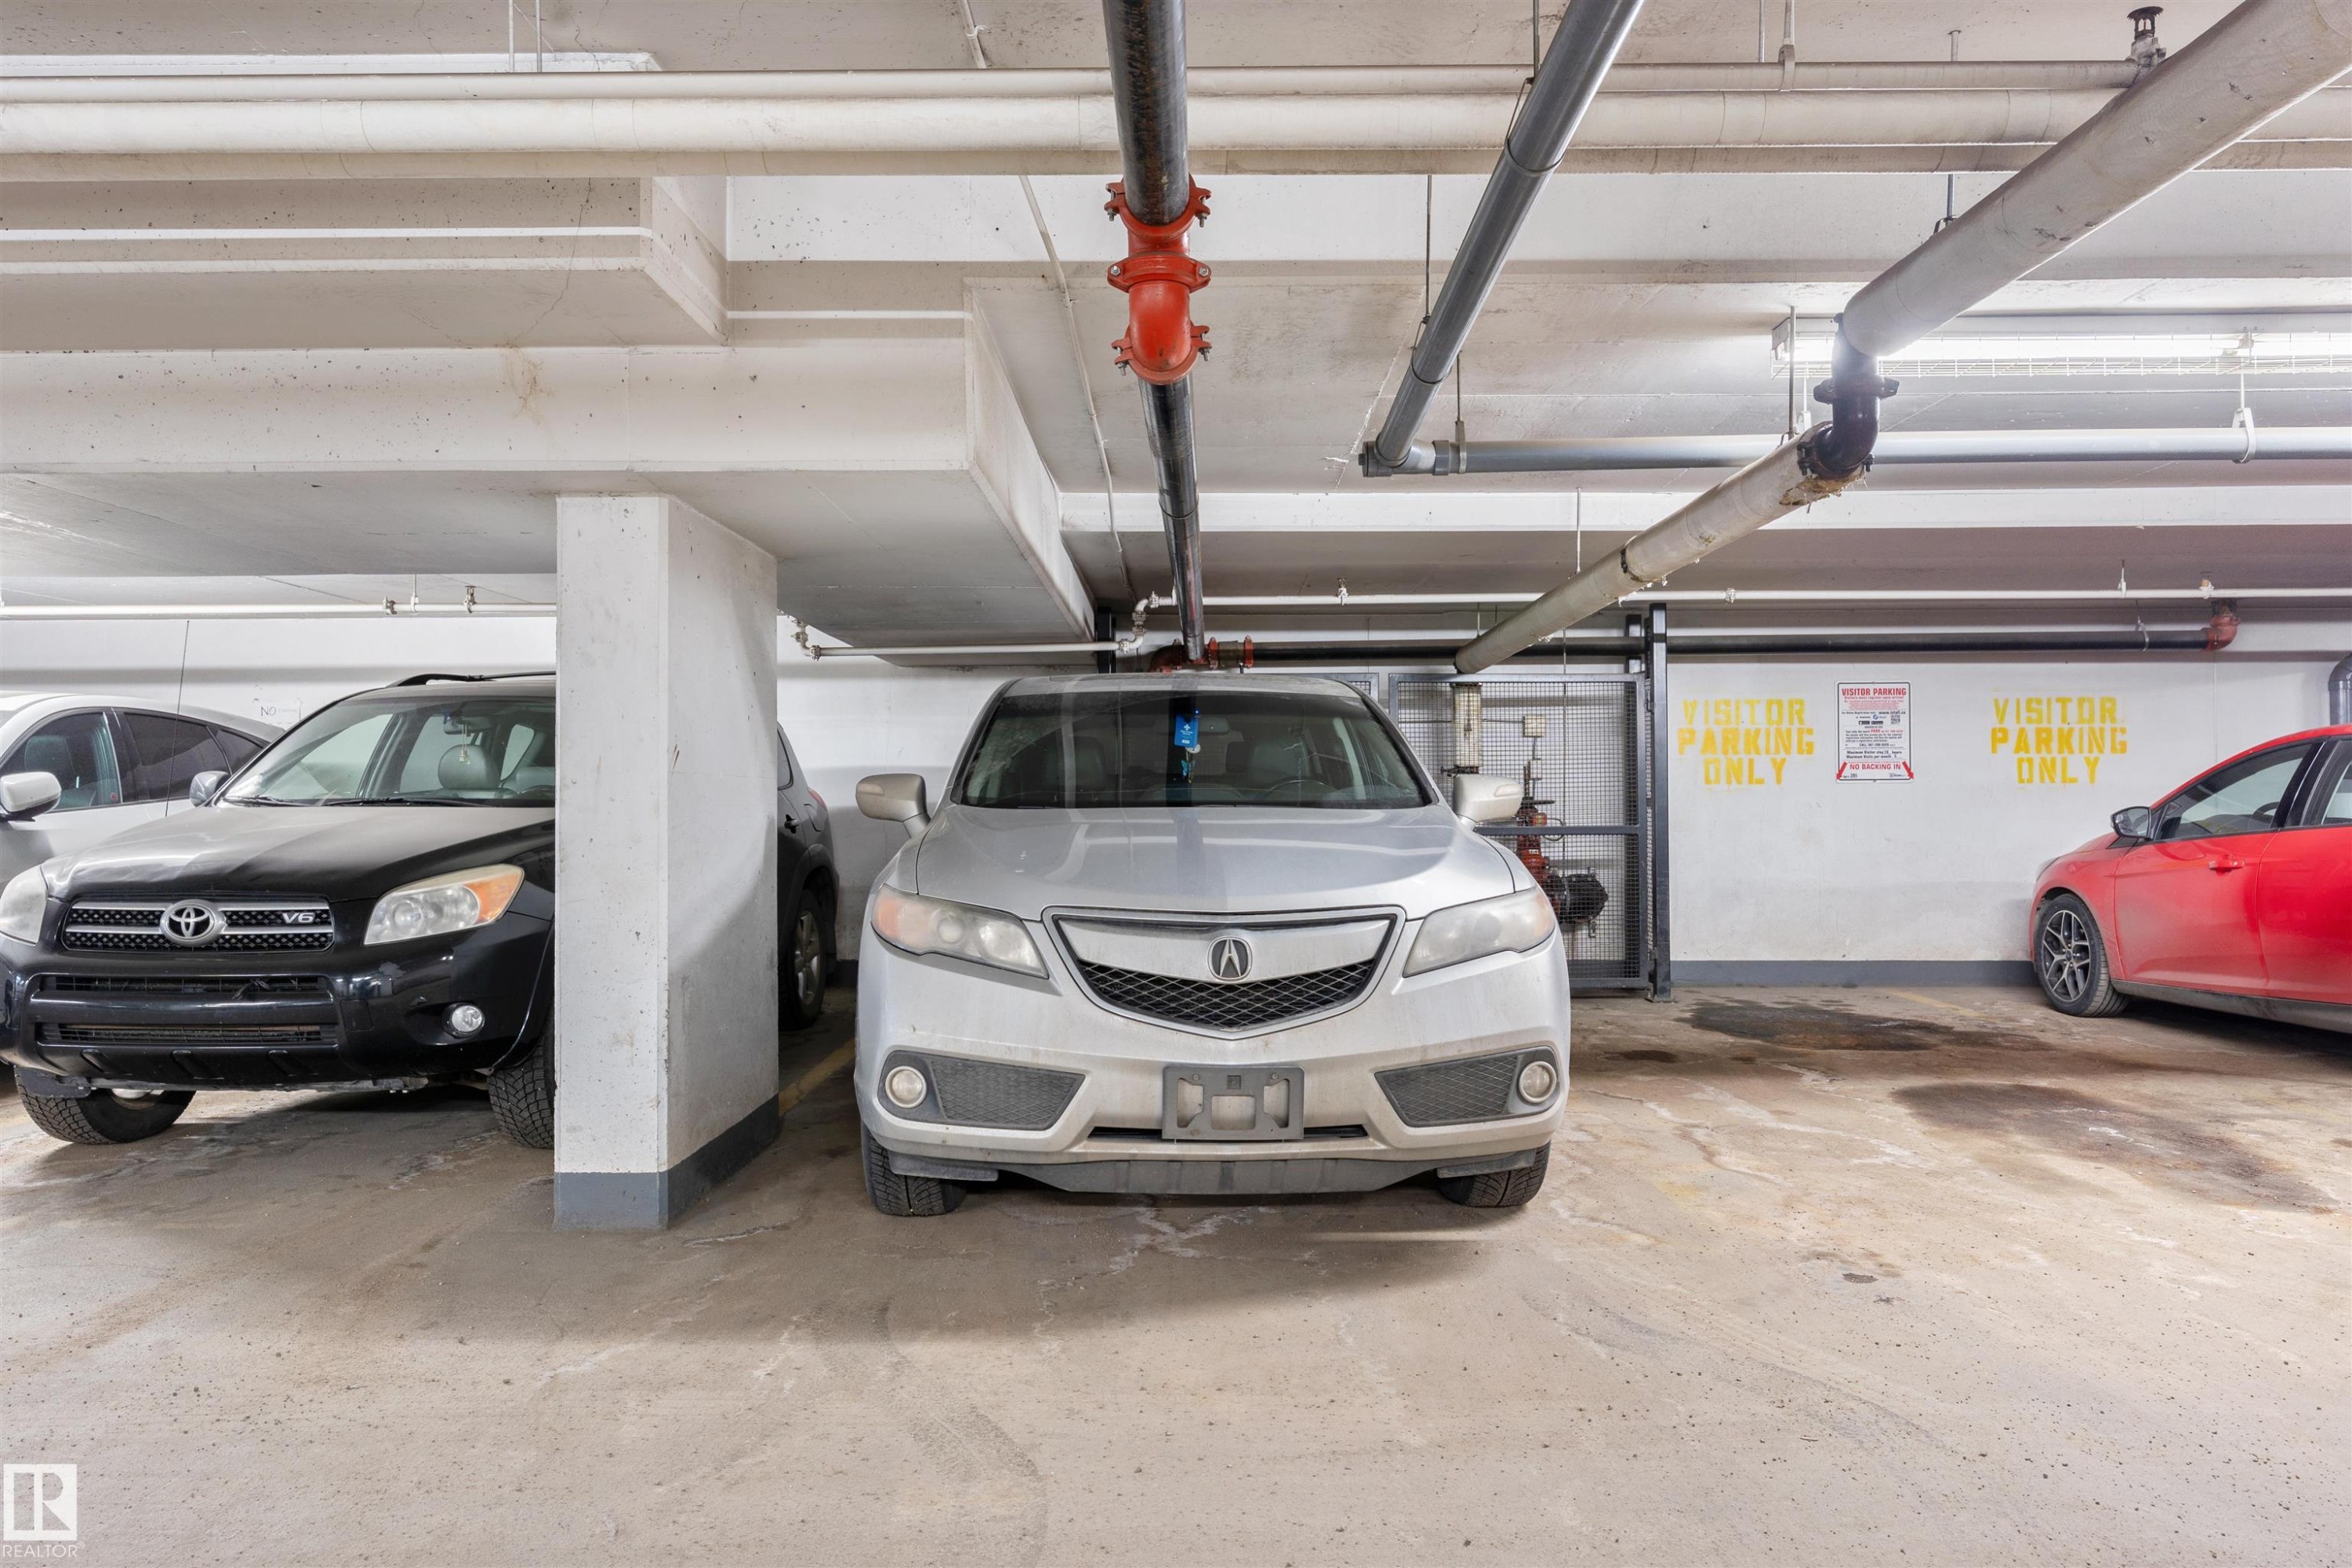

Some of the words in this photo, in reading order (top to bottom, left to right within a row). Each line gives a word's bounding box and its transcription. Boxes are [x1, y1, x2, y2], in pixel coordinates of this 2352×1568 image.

[260, 706, 277, 716] NO
[1682, 698, 1806, 726] VISITOR
[1994, 697, 2117, 724] VISITOR
[1677, 728, 1814, 755] PARKING
[1991, 727, 2127, 754] PARKING
[1703, 757, 1787, 785] ONLY
[2016, 757, 2100, 784] ONLY
[282, 913, 315, 924] V6
